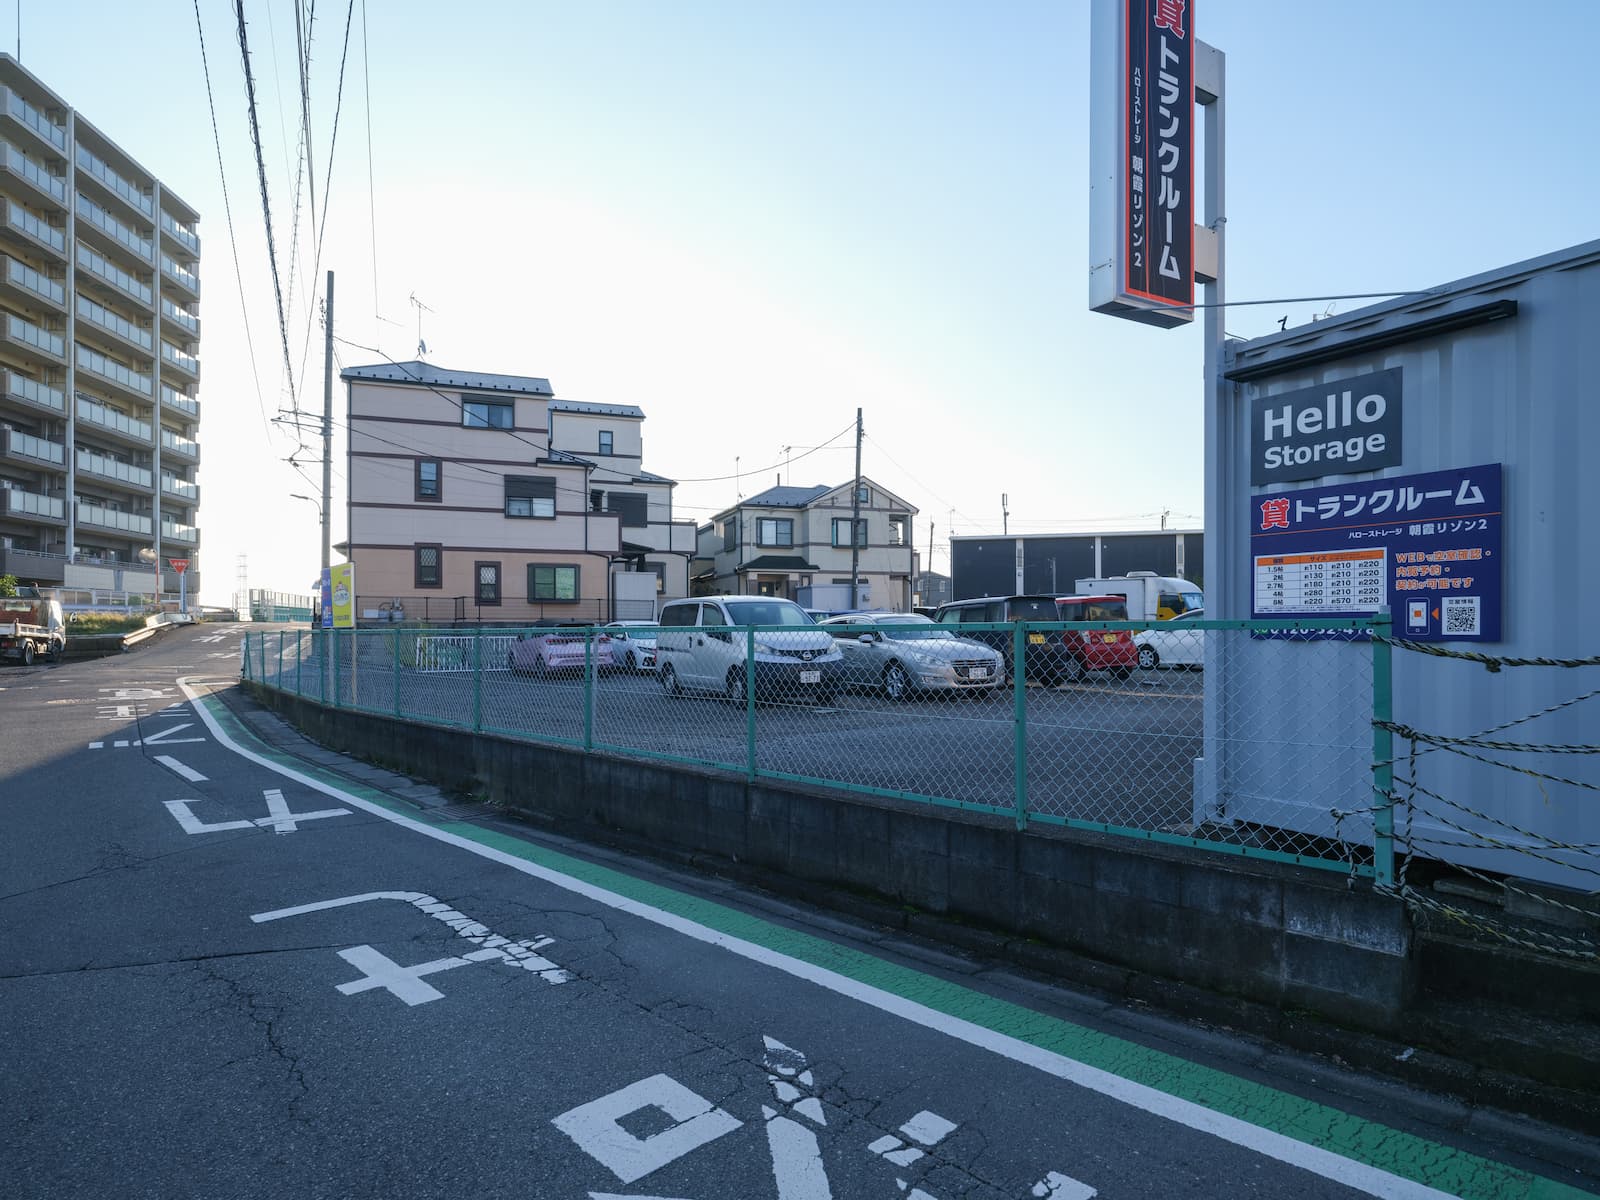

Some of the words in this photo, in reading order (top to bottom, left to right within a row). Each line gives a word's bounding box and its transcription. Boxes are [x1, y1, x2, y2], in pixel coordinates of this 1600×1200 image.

[1264, 390, 1387, 442] Hello
[1264, 432, 1386, 469] Storage
[1260, 479, 1486, 530] 貸トランクルーム
[1348, 527, 1403, 539] ハローストレージ
[1408, 518, 1488, 537] 朝霞リゾン2
